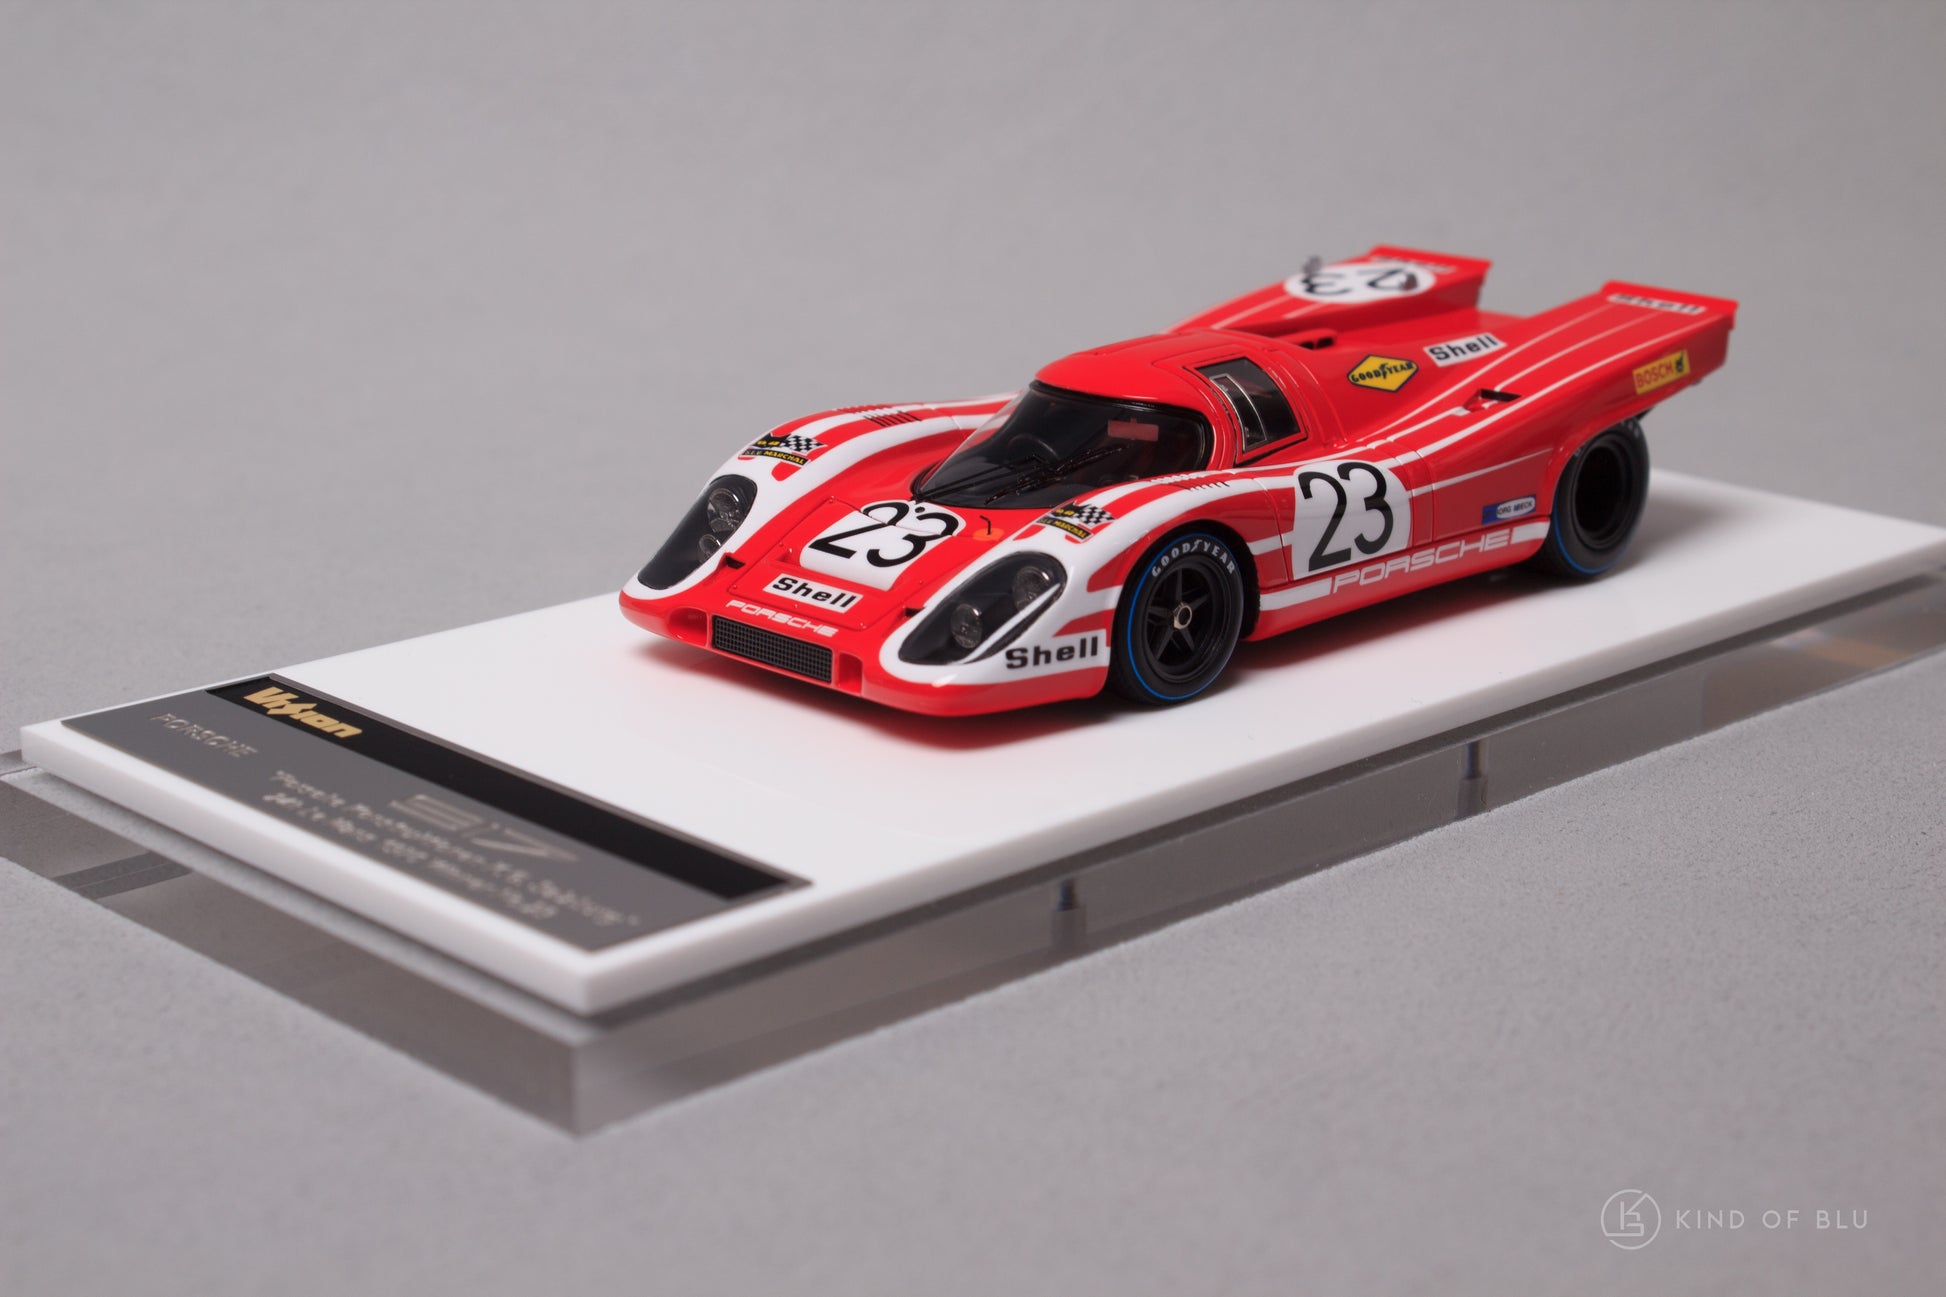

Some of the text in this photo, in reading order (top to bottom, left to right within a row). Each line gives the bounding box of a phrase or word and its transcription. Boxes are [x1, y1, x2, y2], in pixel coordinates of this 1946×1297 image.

[1429, 334, 1498, 361] Shell
[1350, 360, 1414, 383] GOODYEAR
[1635, 359, 1675, 390] BOSCH
[763, 450, 805, 465] MARCHAL
[808, 501, 959, 568] 23
[1298, 461, 1394, 572] 23
[1151, 539, 1236, 577] GOODYEAR
[1333, 528, 1511, 594] PORSCHE
[772, 576, 857, 608] Shell
[725, 599, 839, 638] PORSCHE
[1005, 635, 1098, 670] Shell
[150, 713, 258, 759] PORSCHE
